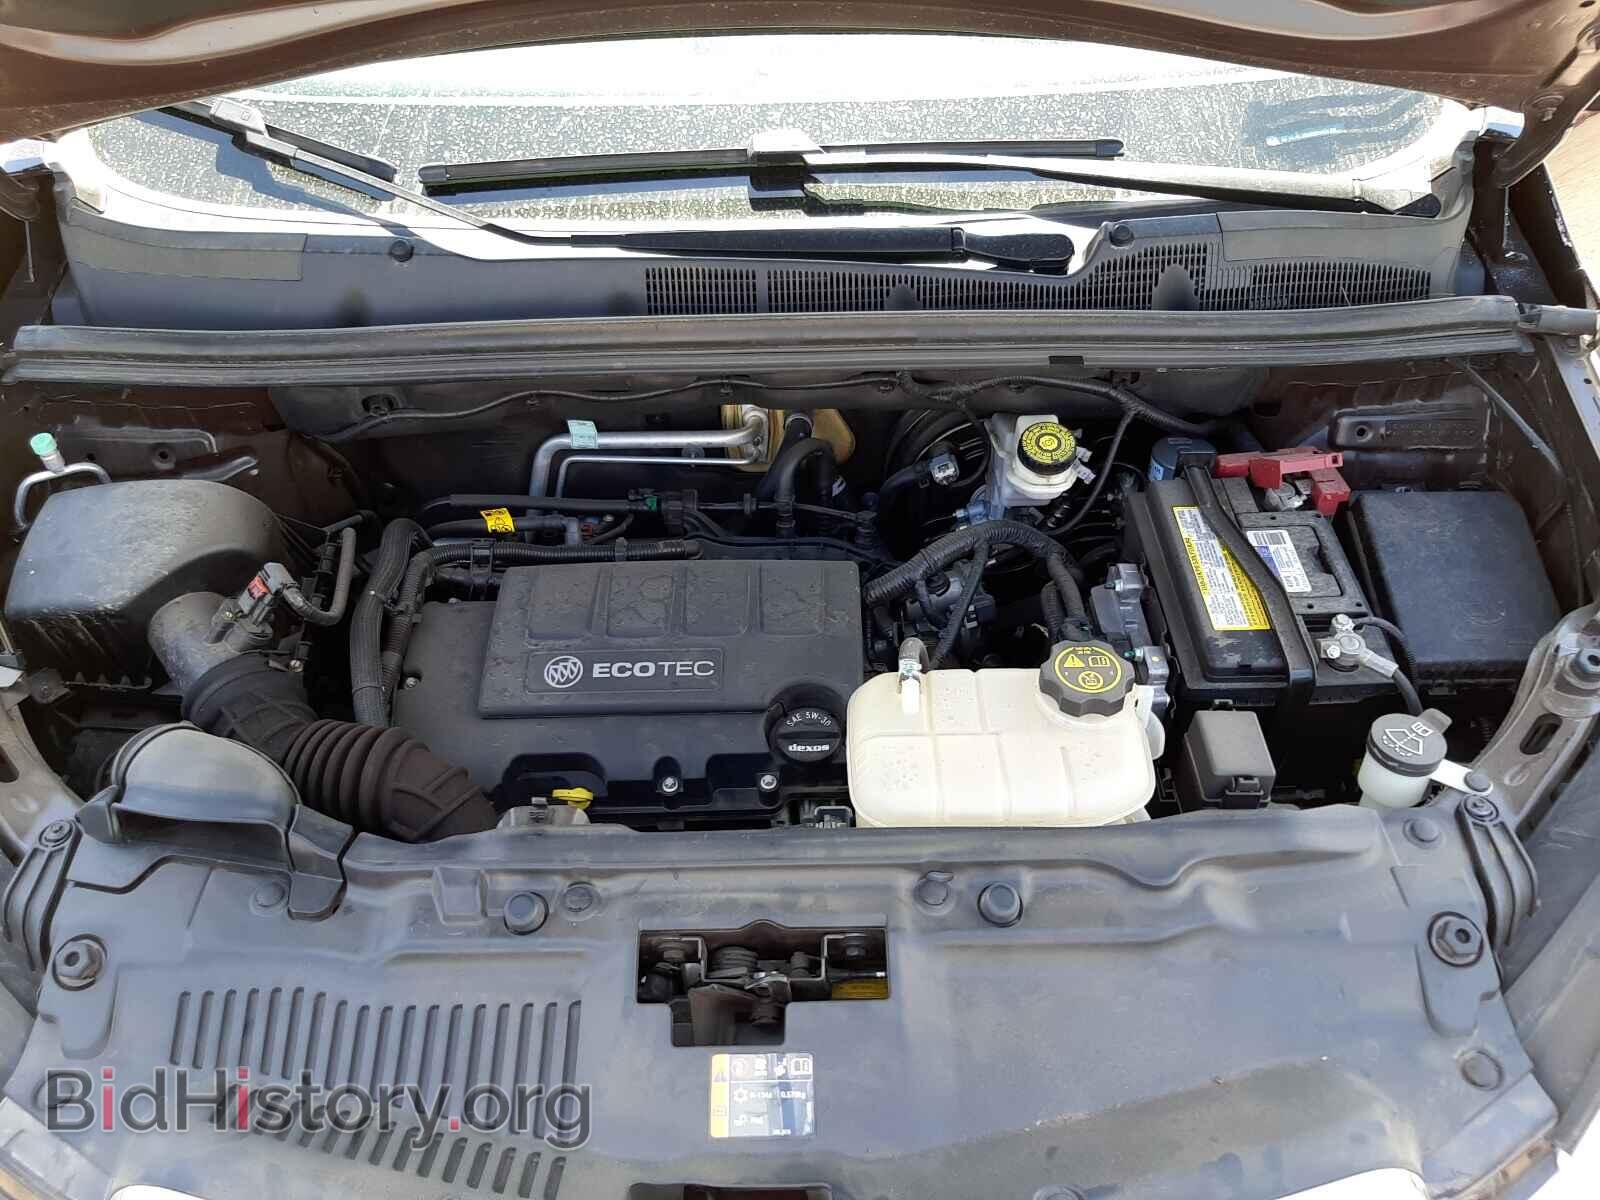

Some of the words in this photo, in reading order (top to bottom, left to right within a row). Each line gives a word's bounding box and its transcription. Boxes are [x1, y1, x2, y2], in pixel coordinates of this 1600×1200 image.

[592, 660, 716, 678] ECOTEC
[786, 713, 802, 727] SAE
[788, 743, 830, 752] dexos
